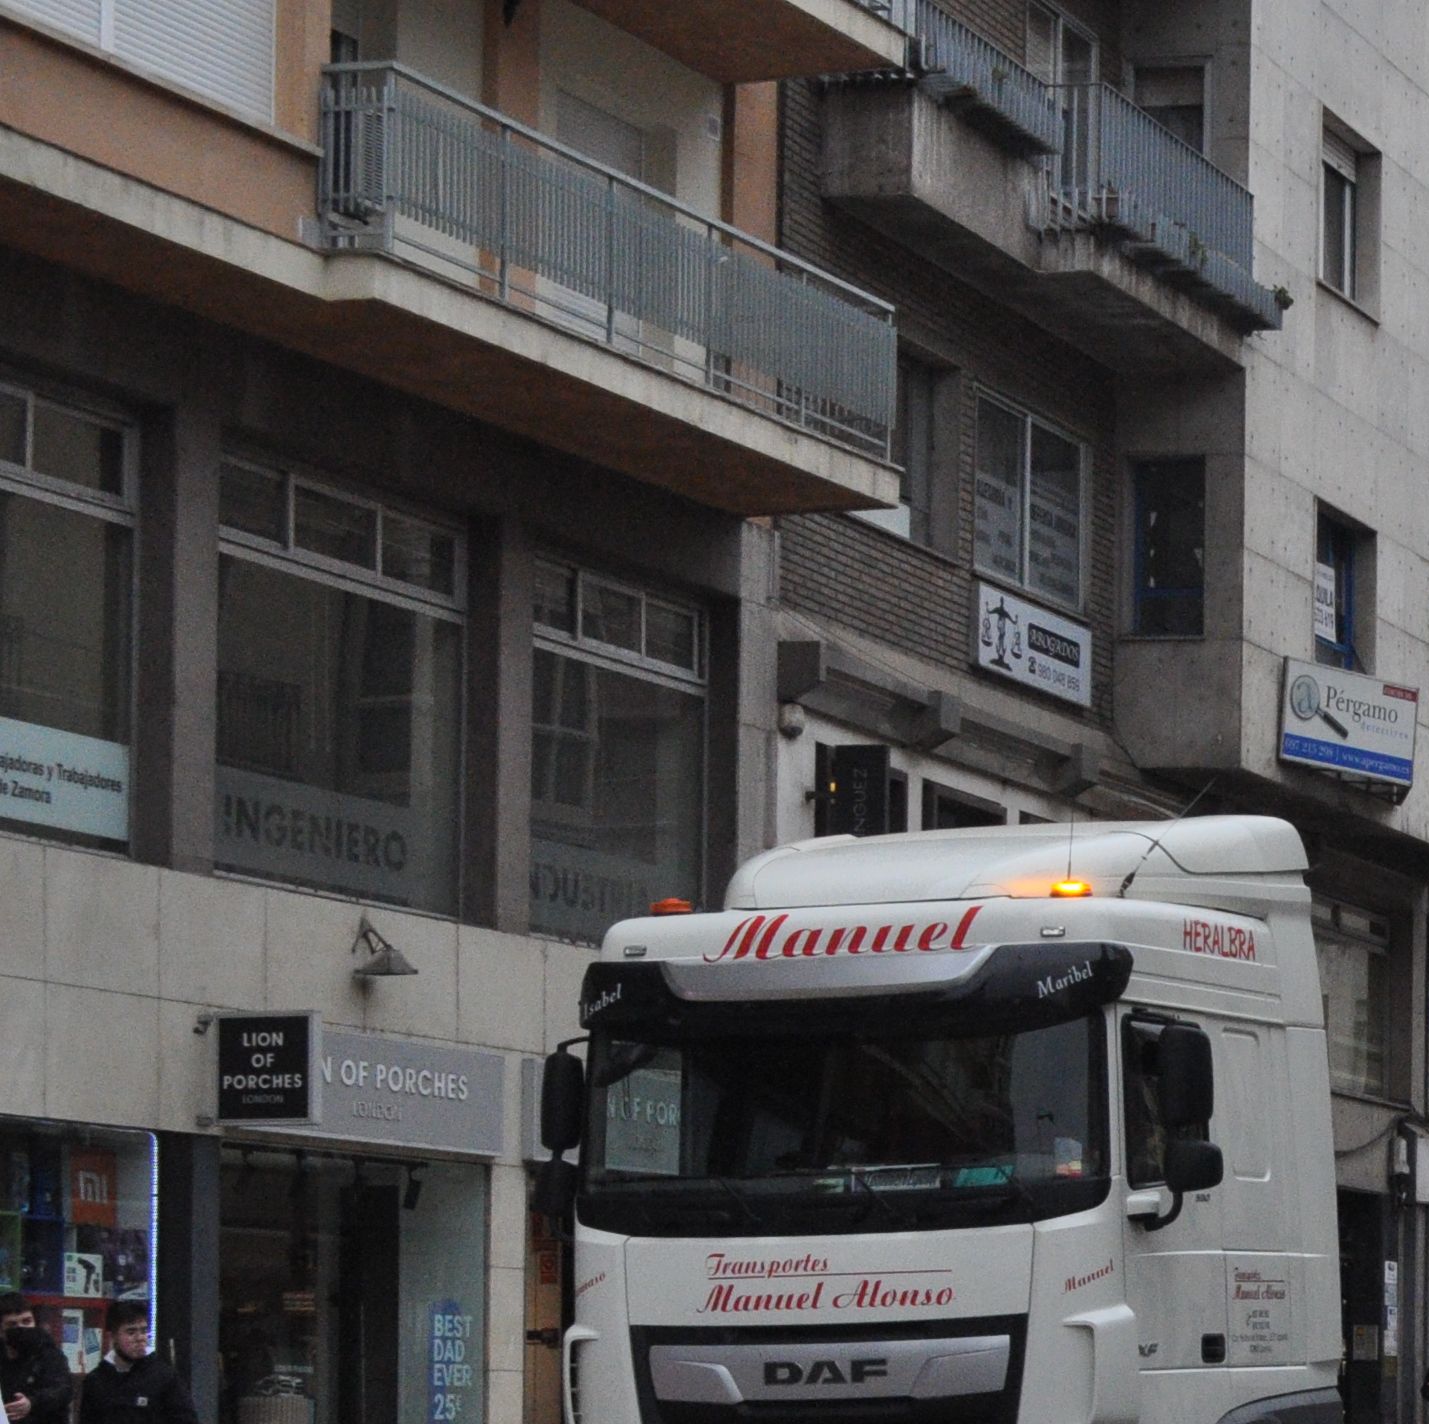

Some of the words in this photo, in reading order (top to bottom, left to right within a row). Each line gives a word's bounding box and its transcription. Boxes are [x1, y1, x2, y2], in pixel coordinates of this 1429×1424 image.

[1029, 629, 1079, 662] ABOGADOS
[1326, 685, 1398, 724] Pérgamo
[11, 780, 52, 804] Zamora
[223, 794, 407, 872] INGENIERO
[703, 905, 984, 963] Manuel
[1183, 918, 1256, 961] HERALBRA
[1037, 960, 1094, 999] Maribel
[583, 983, 621, 1020] Isabel
[243, 1032, 284, 1048] LION
[251, 1053, 275, 1068] OF
[222, 1073, 303, 1090] PORCHES
[340, 1059, 369, 1088] OF
[376, 1062, 469, 1101] PORCHES
[242, 1092, 284, 1104] LONDON
[706, 1253, 830, 1278] Transportes
[1060, 1257, 1114, 1295] Manuel
[696, 1282, 826, 1313] Manuel
[832, 1279, 957, 1310] Alonso
[434, 1314, 473, 1337] BEST
[434, 1338, 465, 1362] DAD
[433, 1363, 473, 1387] EVER
[764, 1358, 888, 1386] DAF
